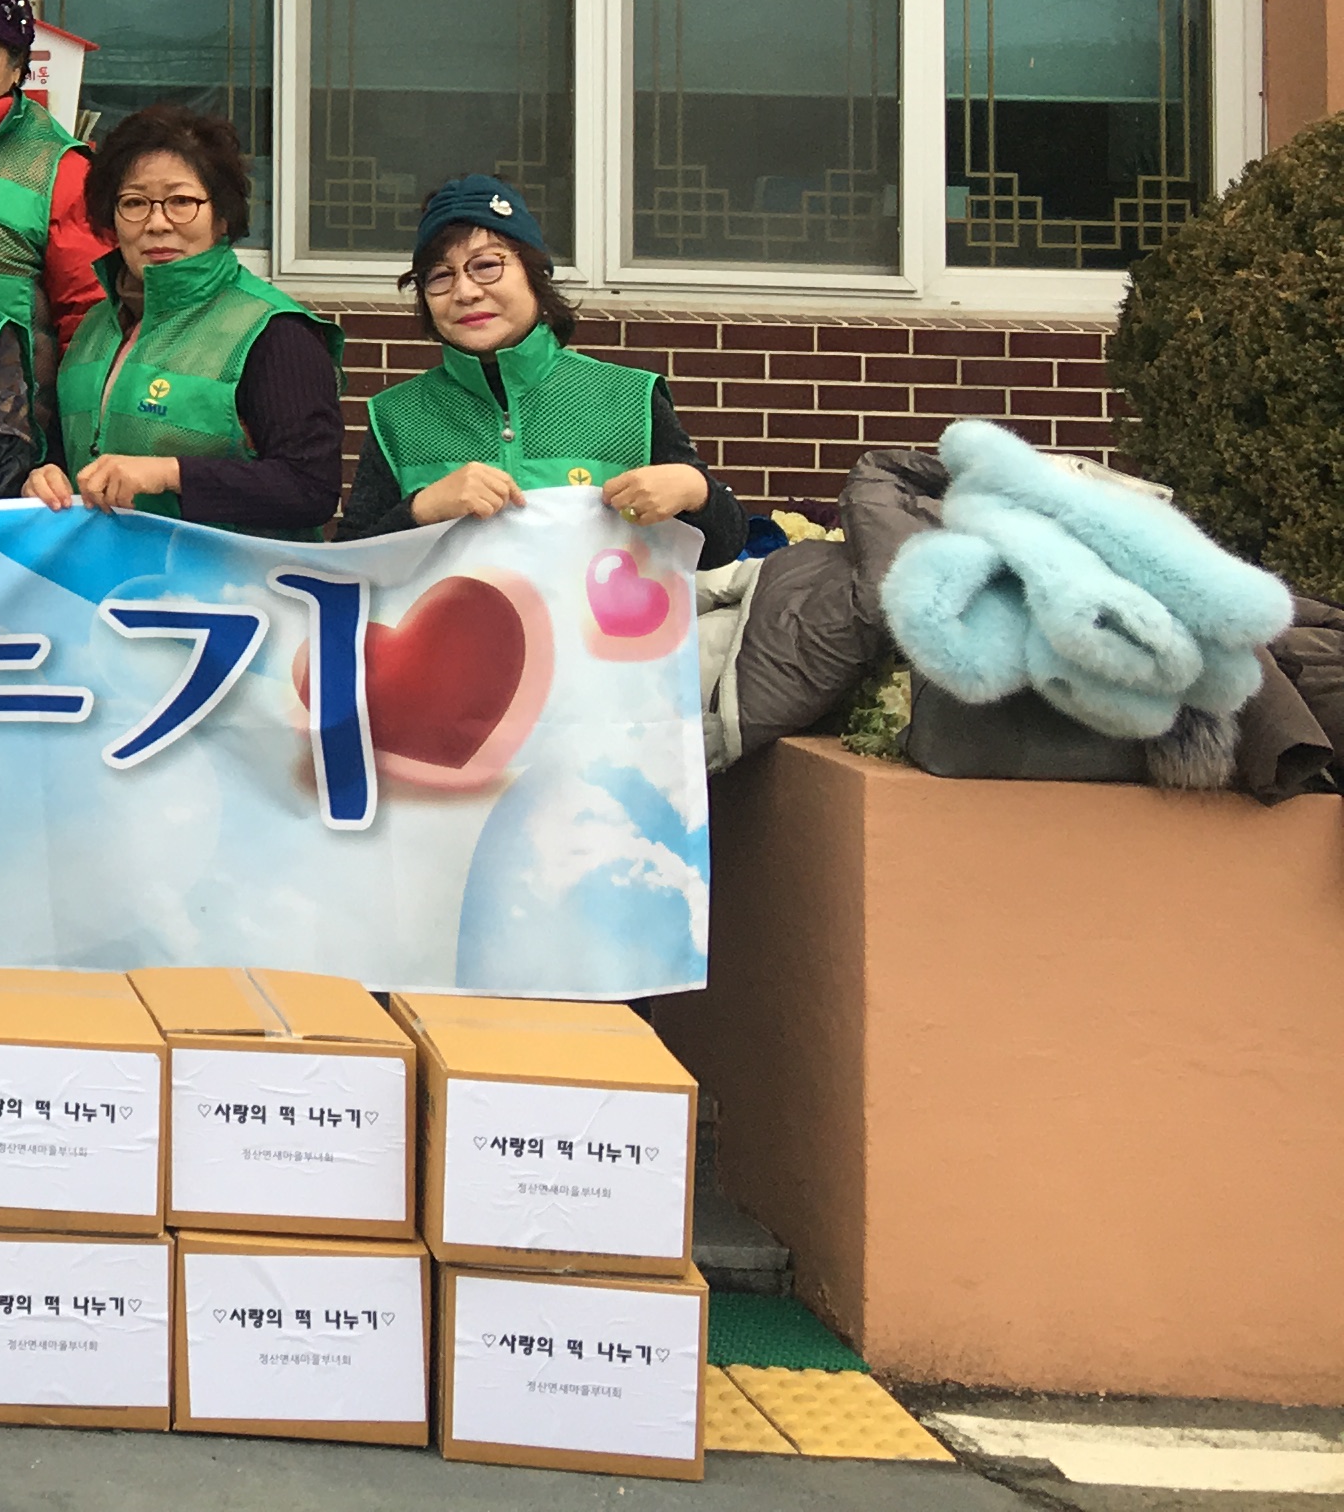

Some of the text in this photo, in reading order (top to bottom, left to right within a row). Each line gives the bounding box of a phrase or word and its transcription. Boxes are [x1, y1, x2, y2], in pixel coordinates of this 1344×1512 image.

[137, 400, 168, 417] SMU
[35, 1099, 51, 1121] 떡
[64, 1101, 116, 1124] 나누기
[214, 1103, 361, 1129] 사랑의 떡 나누기
[490, 1136, 641, 1165] 사랑의 떡 나누기
[44, 1295, 60, 1316] 떡
[73, 1296, 125, 1317] 나누기
[229, 1308, 378, 1331] 사랑의 떡 나누기
[499, 1334, 652, 1366] 사랑의 떡 나누기
